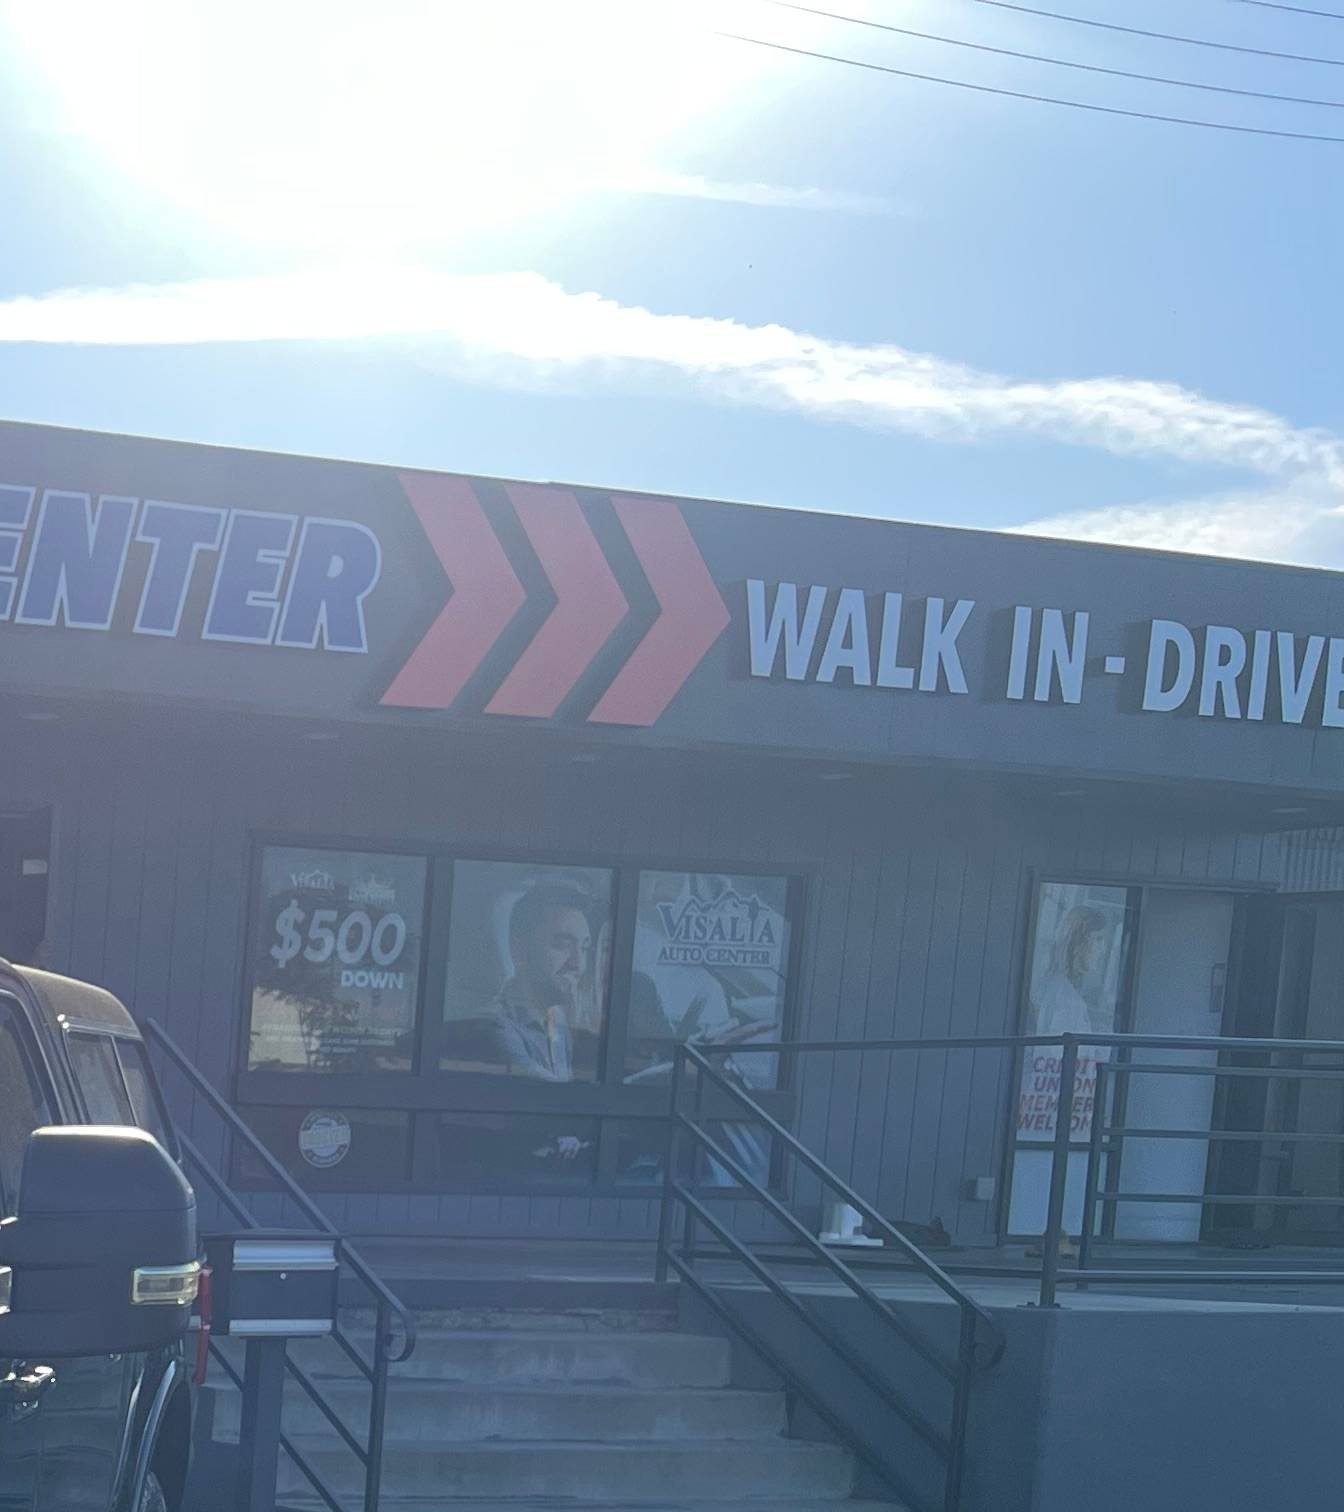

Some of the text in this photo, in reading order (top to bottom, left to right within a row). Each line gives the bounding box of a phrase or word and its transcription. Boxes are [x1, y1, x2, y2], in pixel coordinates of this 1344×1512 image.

[746, 578, 976, 695] WALK
[1006, 605, 1090, 704] IN
[270, 898, 407, 969] $500
[656, 896, 777, 946] VISALIA
[340, 969, 404, 991] DOWN
[657, 946, 771, 966] AUTO CENTER
